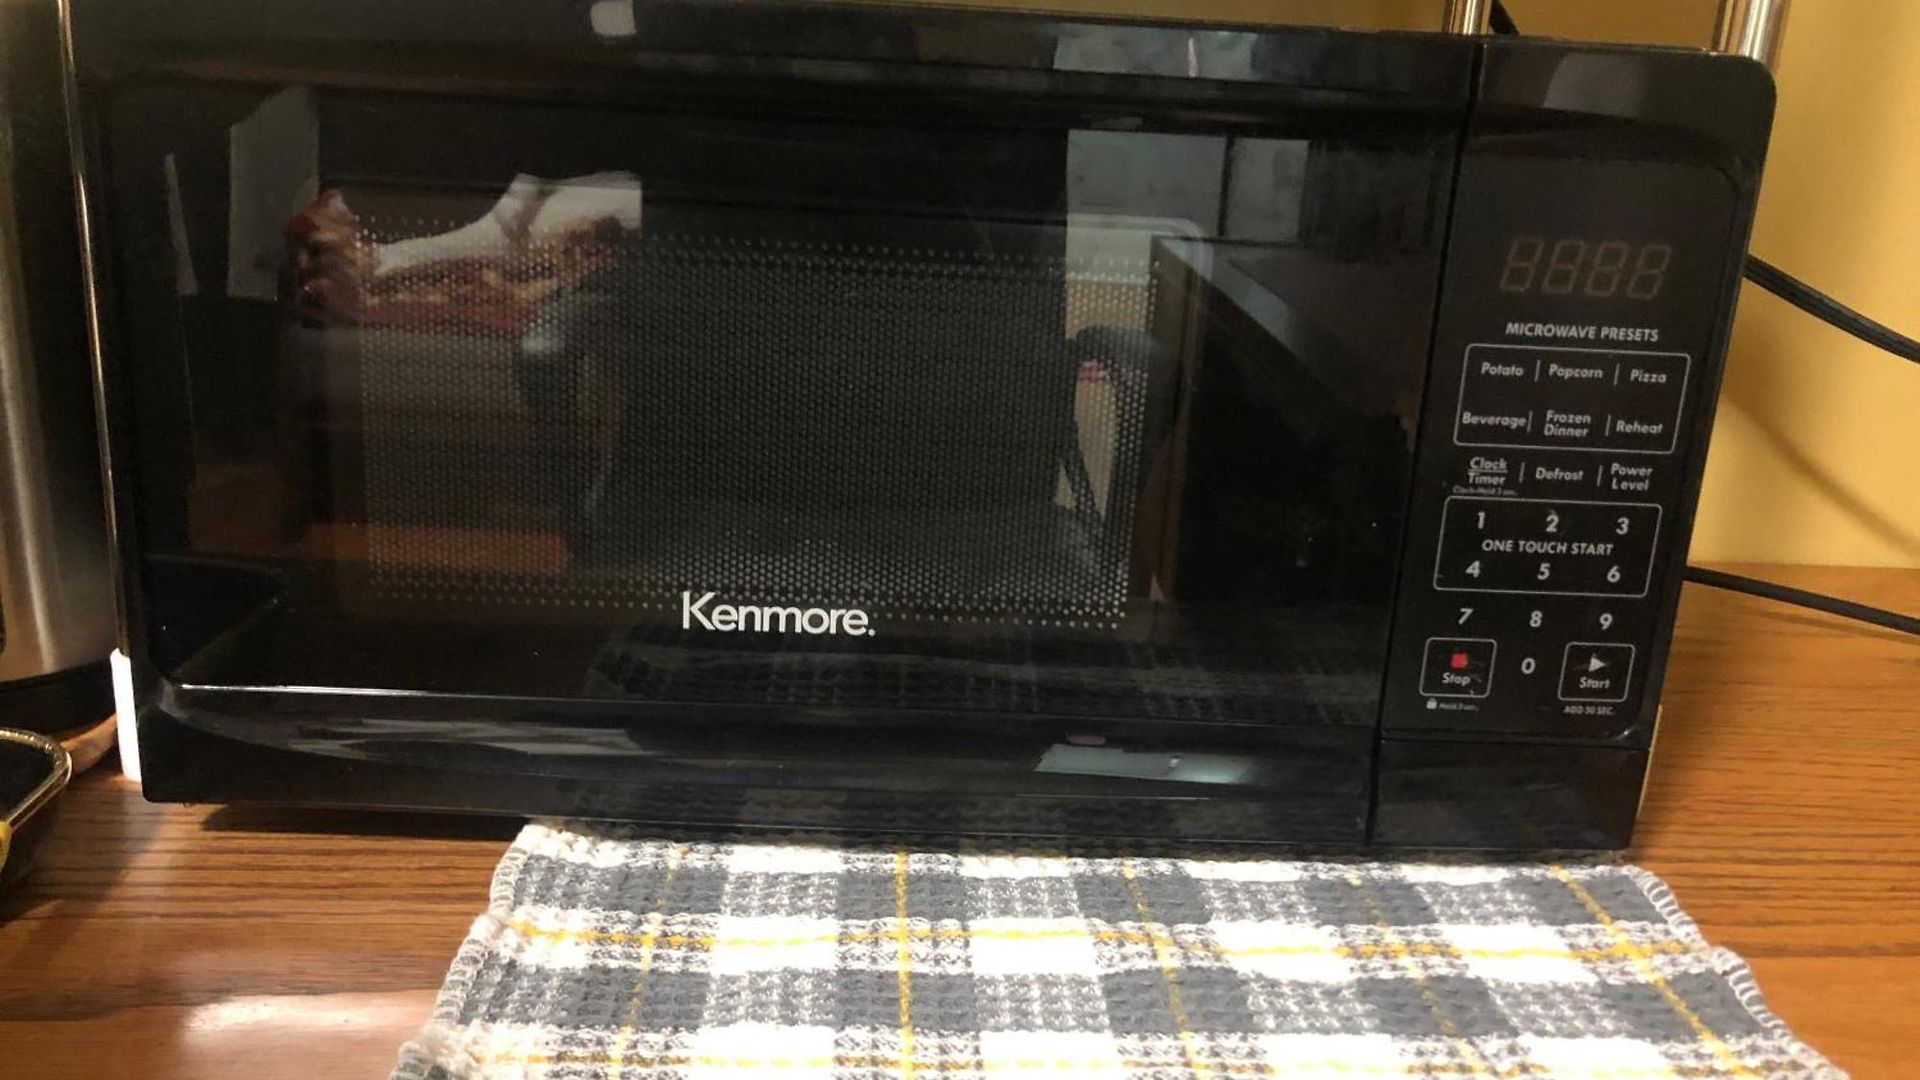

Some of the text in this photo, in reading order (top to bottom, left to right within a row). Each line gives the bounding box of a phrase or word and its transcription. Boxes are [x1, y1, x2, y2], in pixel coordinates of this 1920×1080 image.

[1505, 322, 1659, 342] MICROWAVE PRESETS
[1481, 362, 1524, 377] Potato
[1548, 363, 1603, 380] Popcorn
[1630, 369, 1667, 384] Pizza
[1462, 411, 1527, 429] Beverage
[1546, 410, 1591, 424] Frozen
[1544, 424, 1588, 437] Dinner
[1616, 420, 1662, 435] Reheat
[1469, 456, 1508, 471] Clock
[1611, 463, 1653, 477] Power
[1468, 472, 1505, 485] Timer
[1535, 467, 1584, 481] Defrost
[1612, 479, 1649, 491] Level
[1477, 511, 1486, 530] 1
[1545, 514, 1560, 533] 2
[1615, 517, 1630, 535] 3
[1482, 539, 1614, 556] ONE TOUCH START
[1465, 560, 1482, 578] 4
[1536, 563, 1551, 581] 5
[1606, 565, 1621, 583] 6
[1458, 608, 1473, 625] 7
[1529, 610, 1543, 628] 8
[1599, 613, 1613, 630] 9
[1521, 657, 1536, 675] 0
[1442, 672, 1471, 687] Stop
[1579, 676, 1610, 689] Start
[1564, 705, 1616, 715] ADD 30 SEC.
